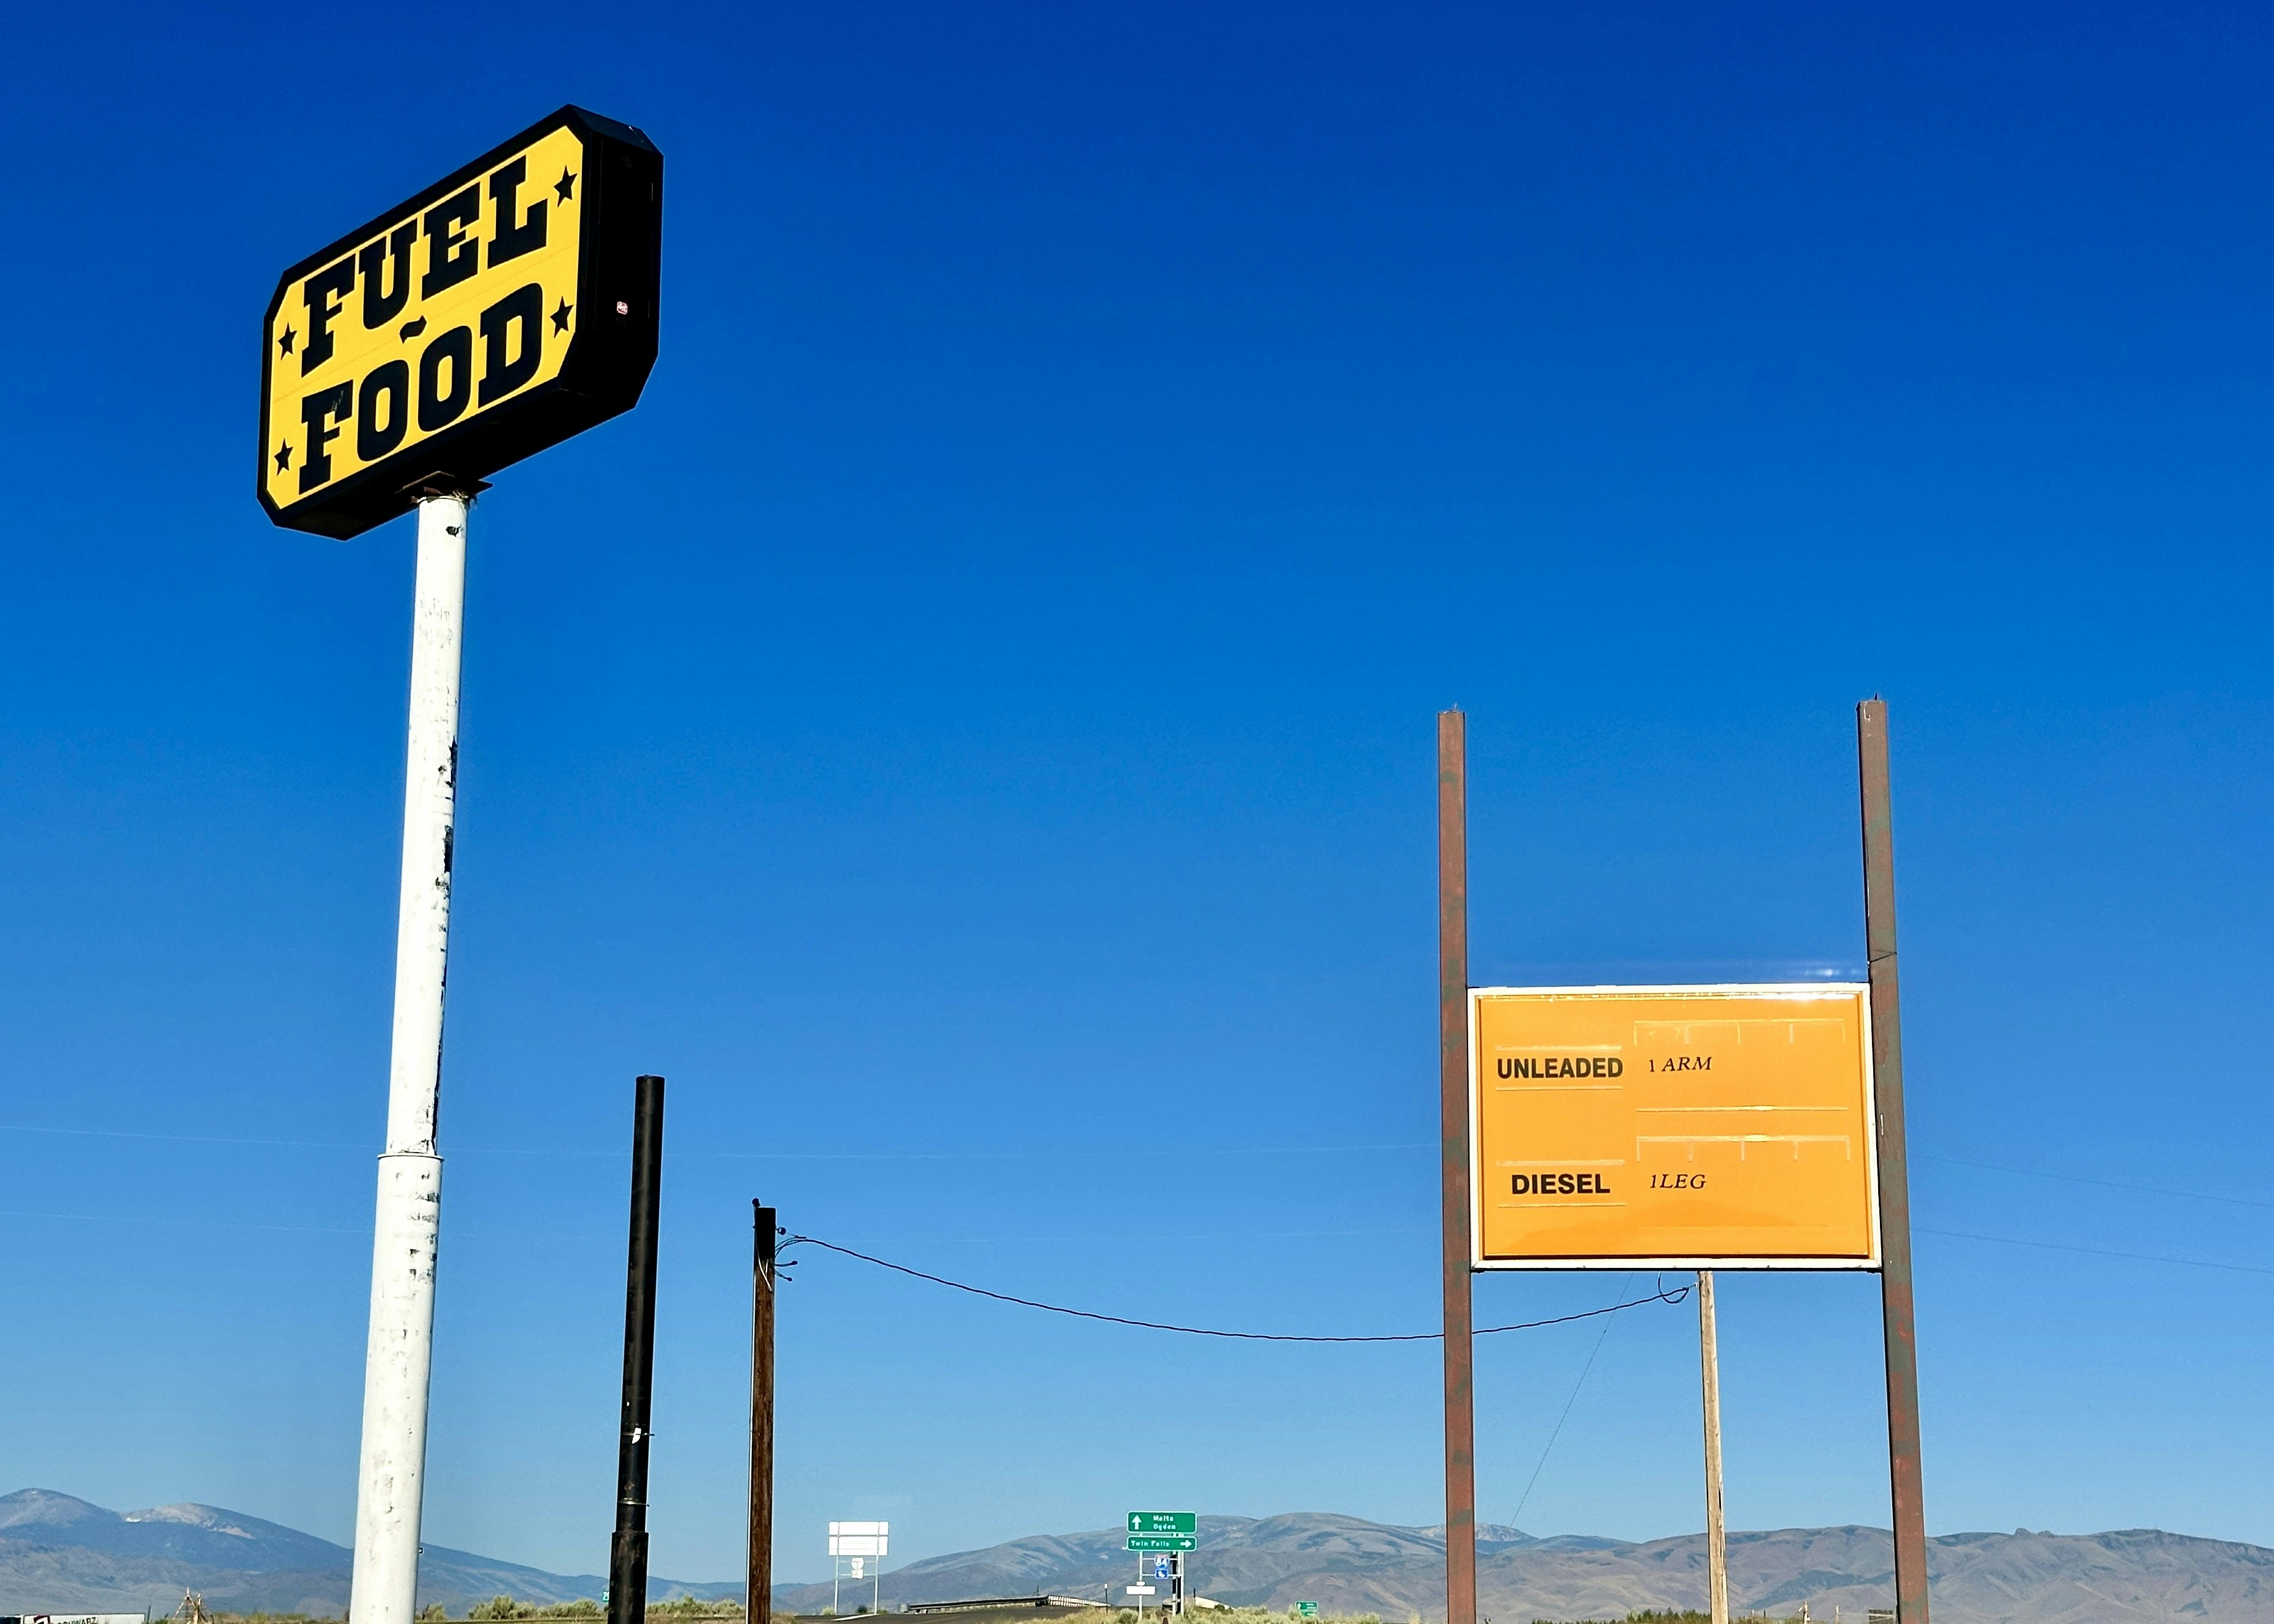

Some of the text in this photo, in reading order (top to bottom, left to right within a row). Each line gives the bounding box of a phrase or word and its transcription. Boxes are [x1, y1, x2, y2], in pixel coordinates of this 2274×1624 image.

[301, 155, 549, 379] FUEL
[299, 282, 544, 495] FOOD
[1497, 1058, 1623, 1079] UNLEADED
[1661, 1056, 1712, 1072] ARM
[1512, 1174, 1611, 1194] DIESEL
[1156, 1558, 1167, 1567] 84
